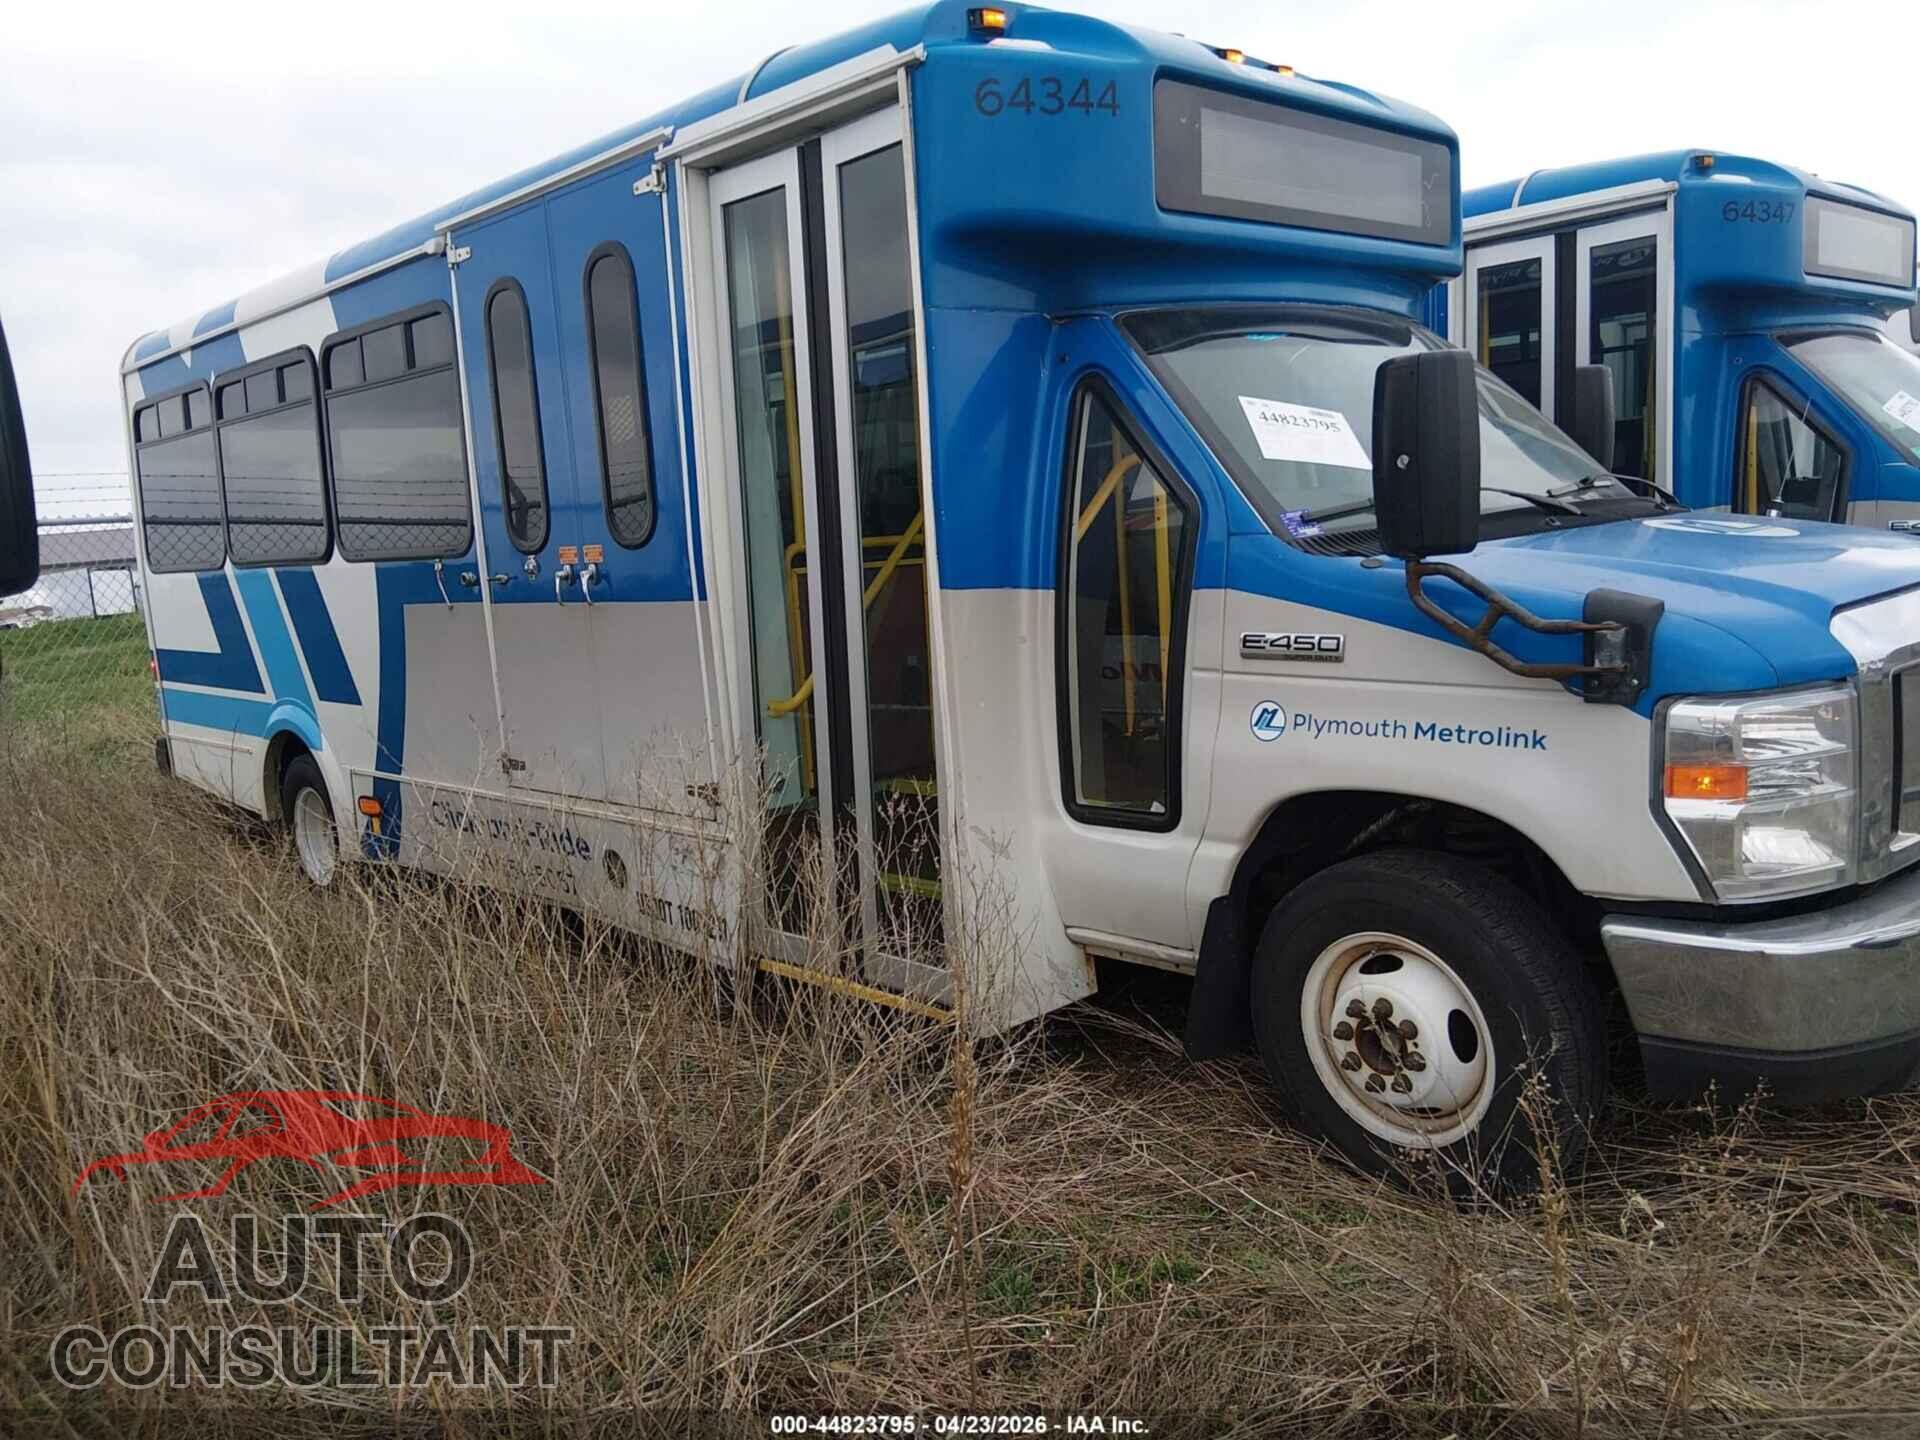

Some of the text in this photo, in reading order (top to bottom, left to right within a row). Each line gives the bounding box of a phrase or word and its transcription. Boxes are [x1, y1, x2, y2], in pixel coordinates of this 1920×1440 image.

[975, 77, 1120, 118] 64344
[1722, 200, 1796, 222] 64347
[1259, 411, 1341, 433] 44823795
[1242, 633, 1341, 652] E-450
[1293, 713, 1548, 750] Plymouth Metrolink
